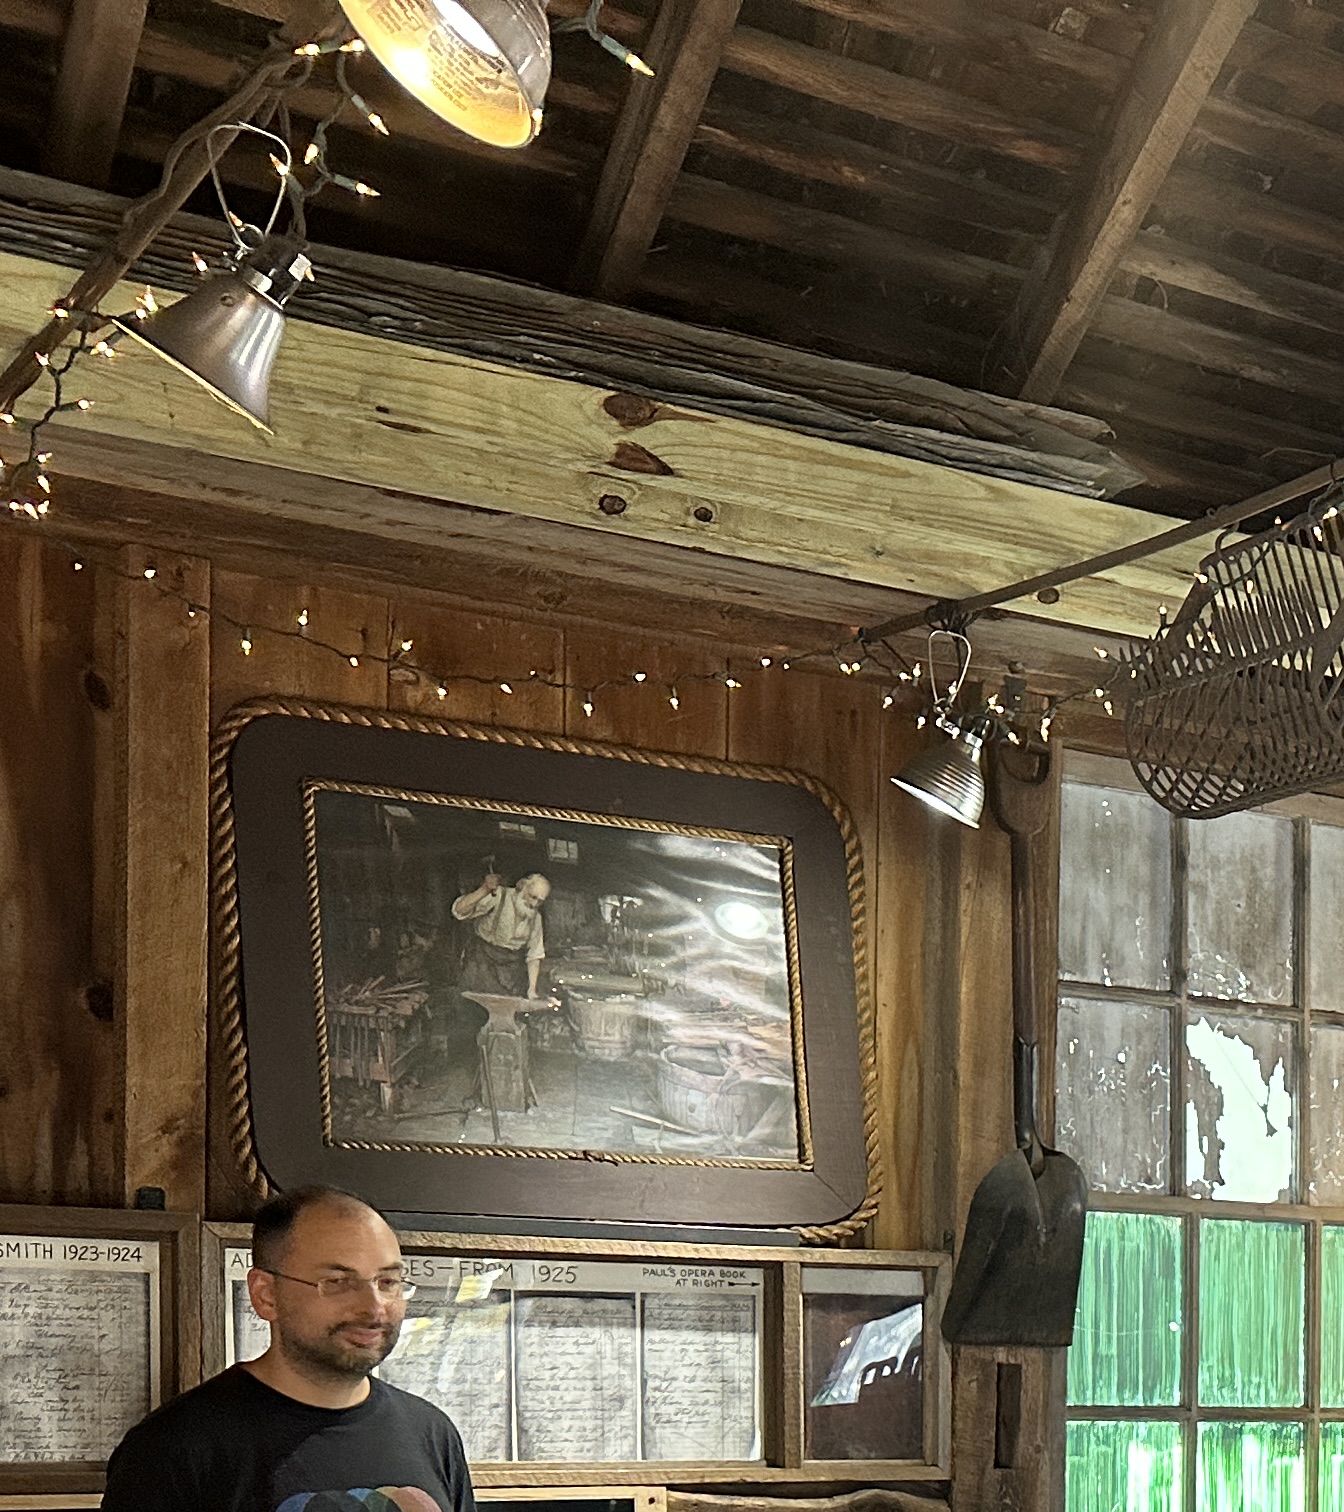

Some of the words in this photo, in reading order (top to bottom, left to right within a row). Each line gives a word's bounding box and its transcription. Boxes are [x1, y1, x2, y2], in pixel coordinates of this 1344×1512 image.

[63, 1244, 143, 1263] 1923-1924
[532, 1263, 579, 1284] 1925
[642, 1265, 676, 1278] PAUL'S
[679, 1268, 716, 1278] OPERA
[719, 1269, 747, 1279] BOOK
[675, 1279, 688, 1287] AT
[692, 1279, 725, 1288] RIGHT
